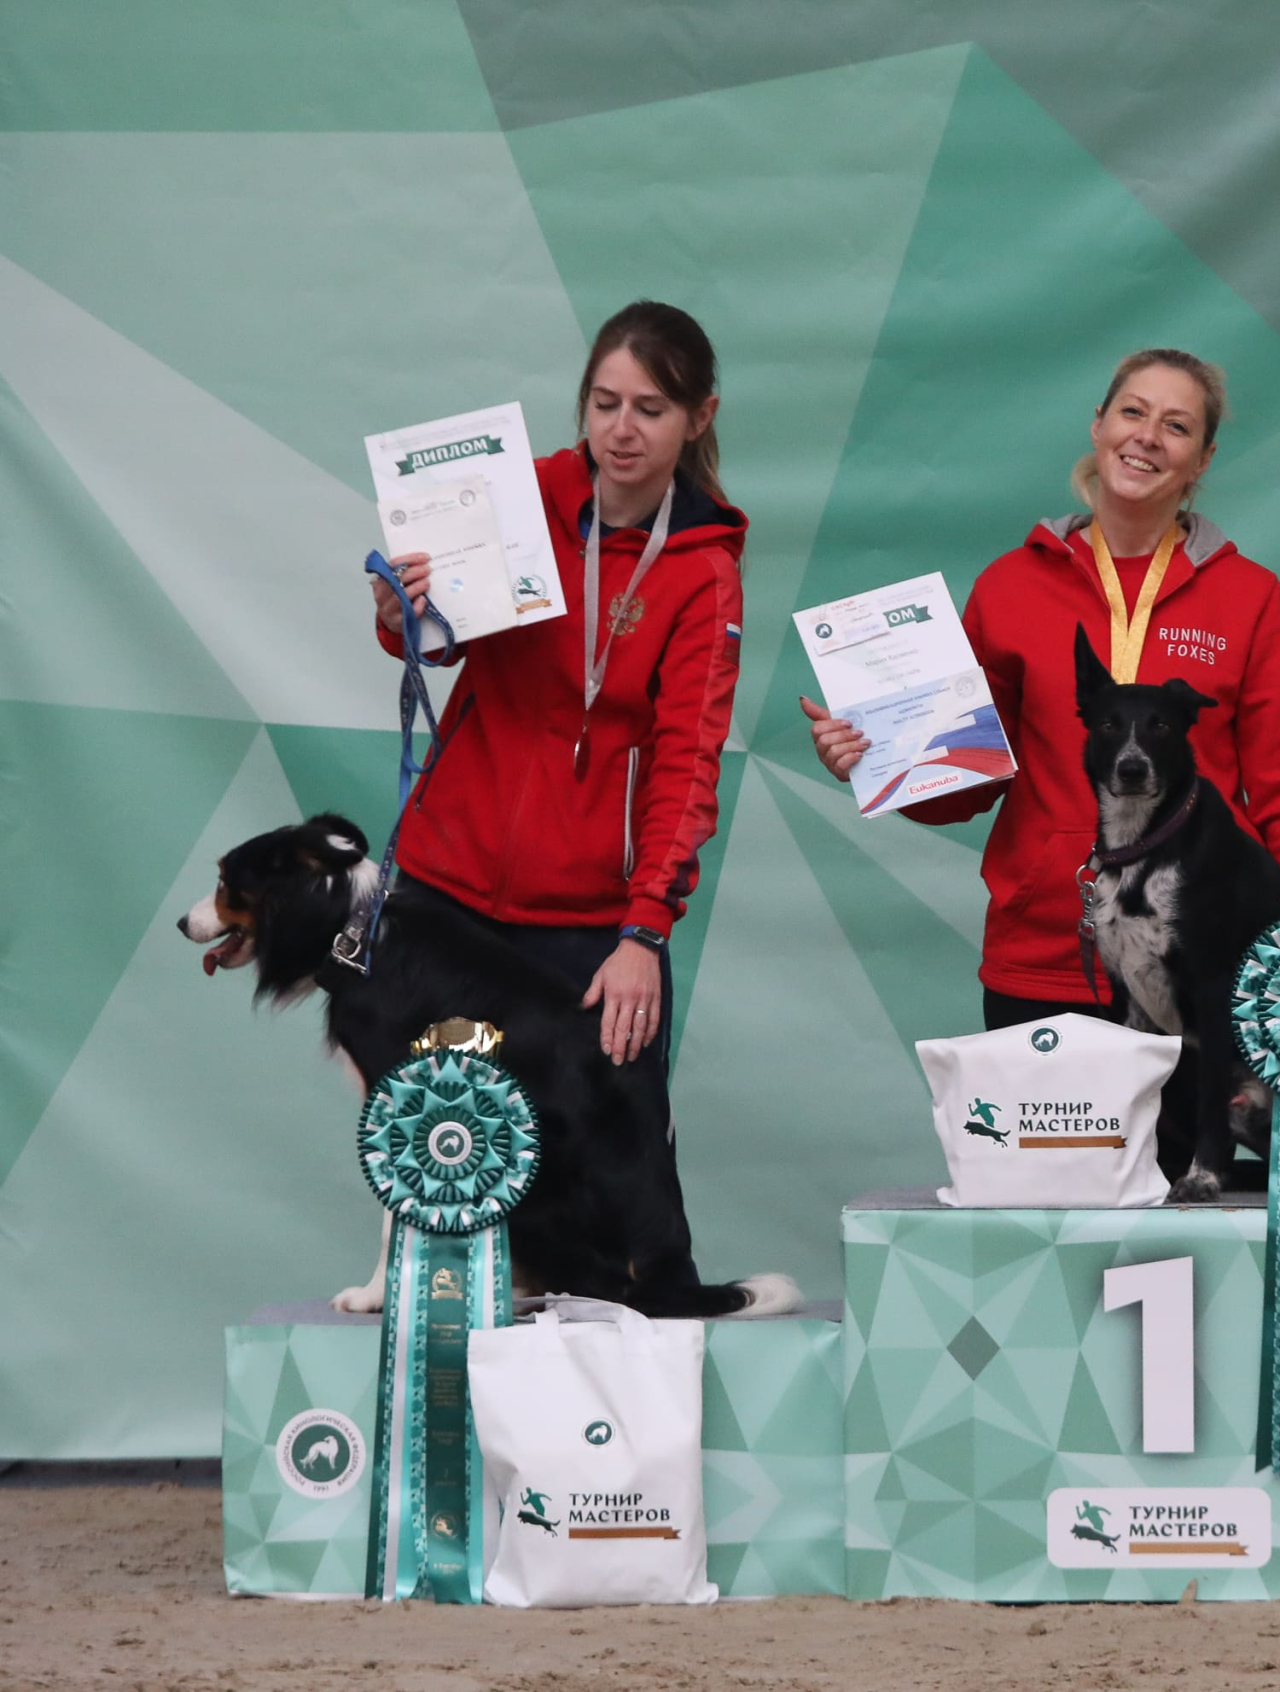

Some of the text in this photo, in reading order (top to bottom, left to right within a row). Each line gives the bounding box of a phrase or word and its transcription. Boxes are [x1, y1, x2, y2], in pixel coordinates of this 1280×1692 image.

[411, 438, 488, 469] ДИПЛОМ
[1159, 627, 1227, 651] RUNNING
[1167, 644, 1215, 665] FOXES
[909, 775, 959, 795] Eukanuba
[1018, 1102, 1093, 1116] ТУРНИР
[1018, 1118, 1121, 1132] МАСТЕРОВ
[1103, 1255, 1195, 1453] 1
[569, 1493, 643, 1507] ТУРНИР
[568, 1508, 671, 1523] МАСТЕРОВ
[1128, 1505, 1209, 1520] ТУРНИР
[1128, 1522, 1238, 1537] МАСТЕРОВ
